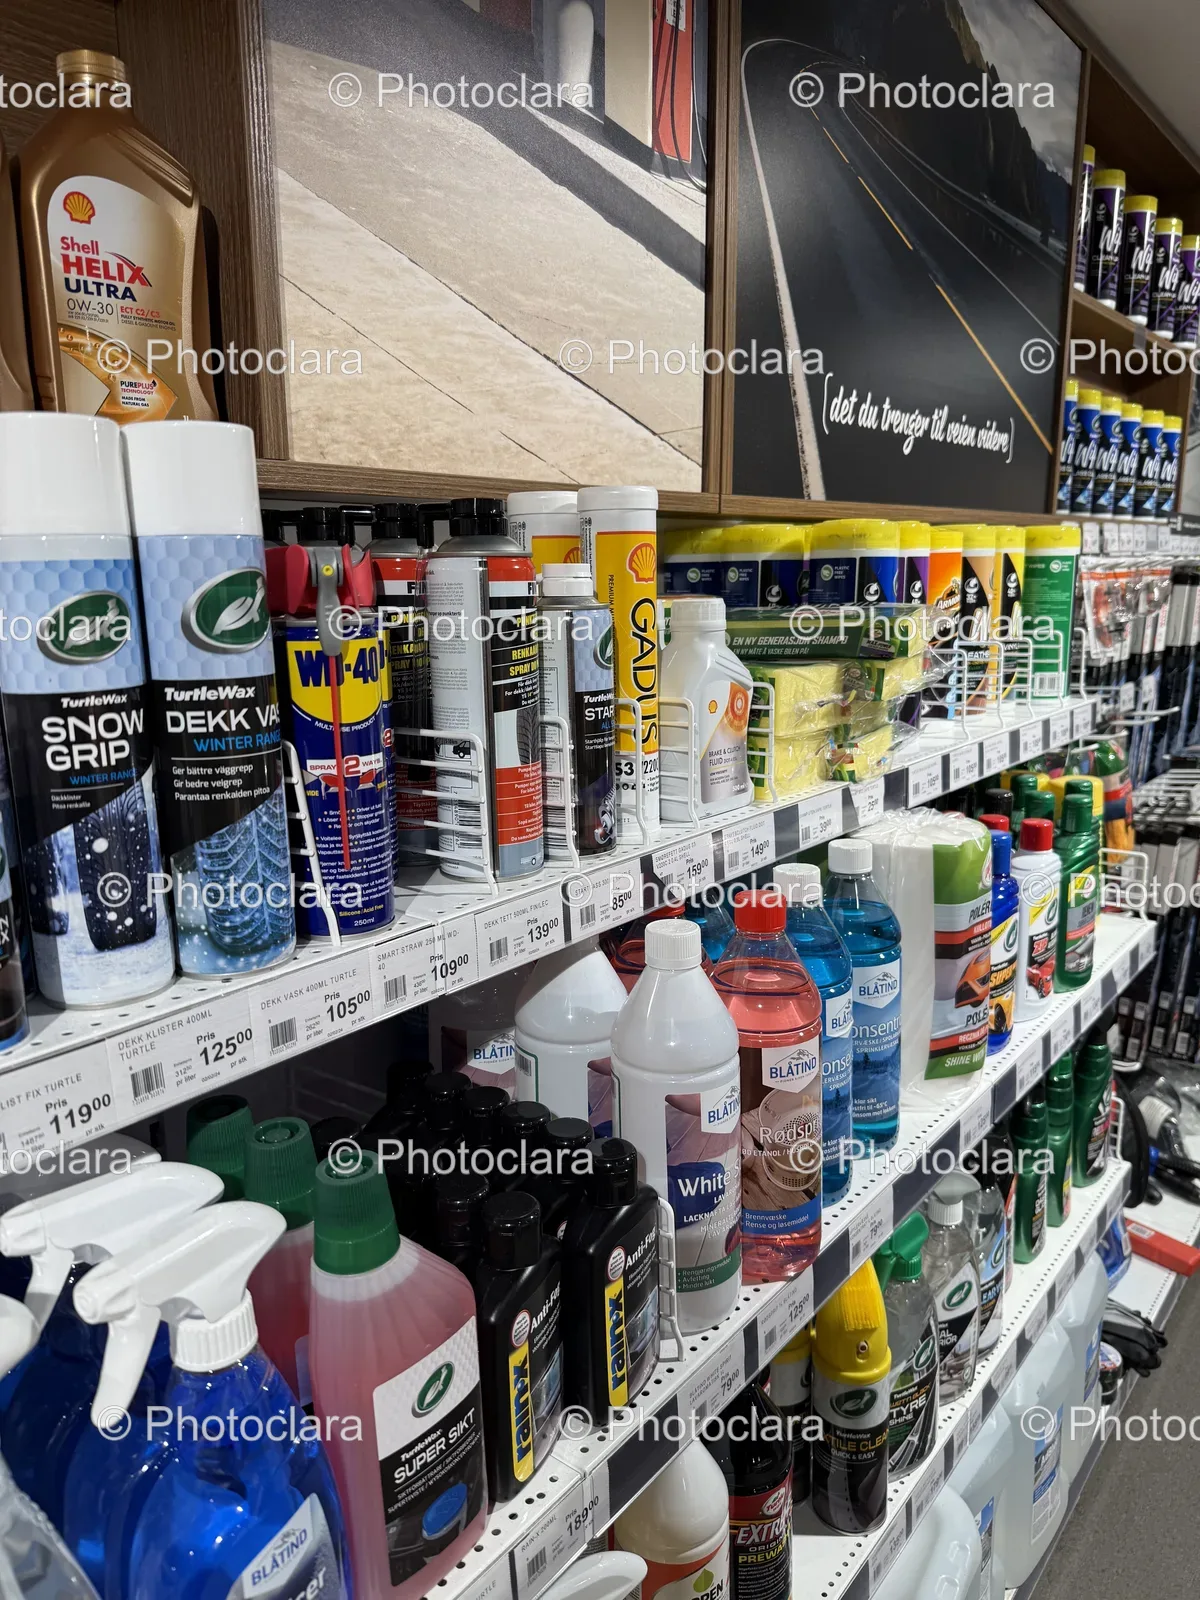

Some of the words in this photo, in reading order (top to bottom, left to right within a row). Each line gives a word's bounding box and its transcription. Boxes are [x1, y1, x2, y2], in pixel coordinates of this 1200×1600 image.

[60, 236, 99, 256] Shell
[60, 252, 152, 287] HELIX
[64, 277, 137, 302] ULTRA
[67, 298, 114, 315] 0W-30
[120, 306, 133, 314] ECT
[120, 380, 154, 390] PUREPLUS
[858, 391, 879, 430] du
[881, 397, 930, 455] trenger
[930, 404, 949, 442] til
[947, 414, 977, 447] veien
[733, 637, 743, 645] EN
[744, 636, 756, 645] NY
[757, 635, 811, 645] GENERASJON
[509, 663, 530, 676] SPRAY
[60, 693, 127, 709] TurtleWax
[164, 686, 256, 702] TurtleWax
[41, 707, 144, 744] SNOW
[165, 706, 251, 734] DEKK
[352, 717, 376, 732] PRODUCT
[194, 734, 254, 753] WINTER
[45, 738, 130, 772] GRIP
[709, 749, 722, 757] BRAKE
[344, 756, 361, 777] 2
[362, 758, 380, 767] WAYS
[710, 758, 723, 766] FLUID
[70, 772, 109, 786] WINTER
[172, 766, 186, 776] Ger
[173, 779, 184, 788] Gir
[185, 777, 209, 788] bedre
[210, 777, 243, 790] veigrep
[174, 791, 210, 800] Parantaa
[354, 917, 374, 926] 250ml
[484, 918, 499, 930] DEKK
[499, 913, 512, 926] TETT
[527, 917, 538, 927] Pris
[377, 948, 399, 962] SMART
[401, 941, 423, 955] STRAW
[429, 954, 443, 964] Pris
[377, 962, 386, 971] 40
[260, 996, 282, 1011] DEKK
[284, 989, 305, 1004] VASK
[306, 978, 329, 995] 400ML
[330, 969, 357, 985] TURTLE
[859, 979, 898, 996] BLÅTIND
[324, 990, 340, 1003] Pris
[117, 1037, 144, 1051] DEKK
[146, 1019, 184, 1040] KLISTER
[186, 1010, 213, 1028] 400ML
[196, 1030, 216, 1044] Pris
[120, 1041, 156, 1062] TURTLE
[944, 1051, 970, 1068] SHINE
[769, 1056, 817, 1080] BLÅTIND
[26, 1087, 42, 1099] FIX
[43, 1073, 83, 1092] TURTLE
[45, 1098, 68, 1113] Pris
[678, 1170, 731, 1197] White
[745, 1212, 787, 1220] Brennvæske
[778, 1214, 809, 1228] løsemiddel
[890, 1393, 927, 1419] TYRE
[889, 1412, 914, 1426] SHINE
[394, 1437, 446, 1484] SUPER
[448, 1407, 475, 1443] SIKT
[401, 1430, 440, 1461] TurtleWax
[858, 1451, 875, 1459] EASY
[565, 1509, 577, 1522] Pris
[251, 1528, 308, 1586] BLÅTIND
